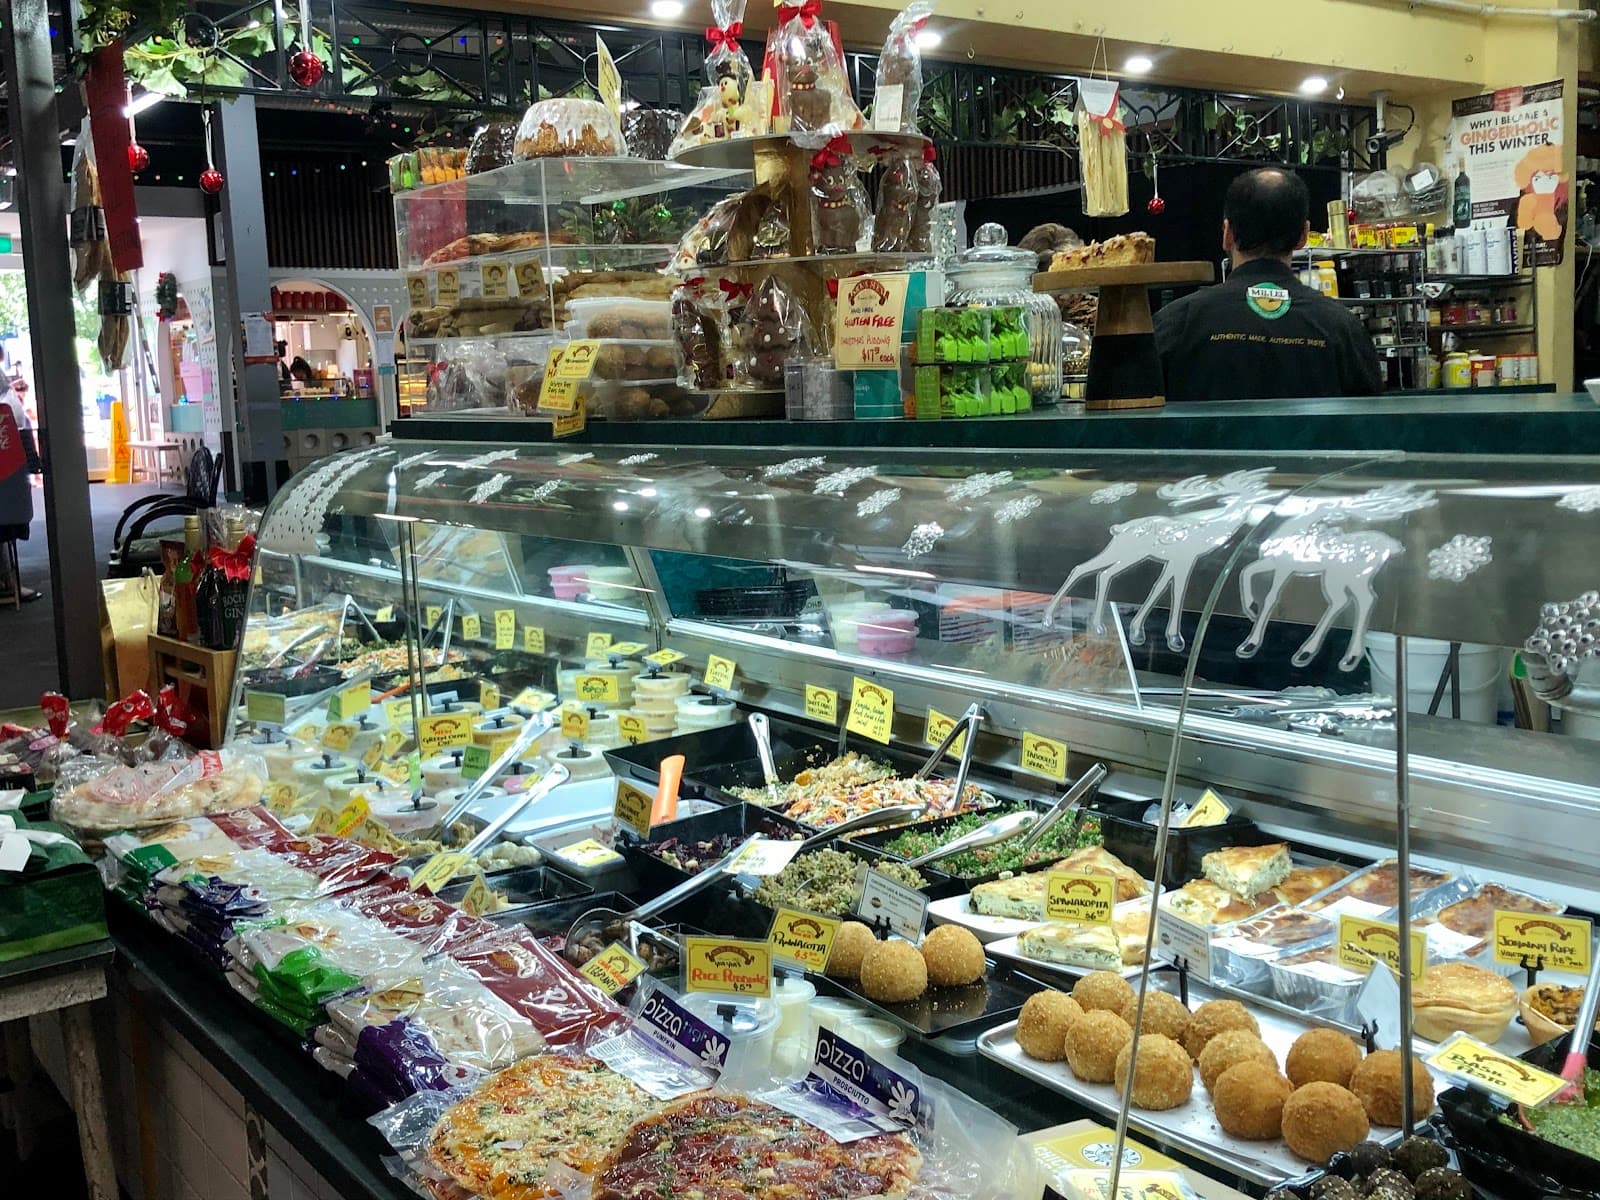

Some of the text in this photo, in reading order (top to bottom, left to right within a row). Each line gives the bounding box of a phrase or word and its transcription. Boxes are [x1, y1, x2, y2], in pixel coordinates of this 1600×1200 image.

[1460, 116, 1559, 145] GINGERHOLIC
[1470, 119, 1492, 130] WHY
[1469, 133, 1549, 156] THIS WINTER
[872, 315, 895, 328] FREE
[1049, 895, 1109, 910] SPANAKOPITA
[1498, 935, 1546, 952] JOHNNY
[692, 968, 721, 981] RICE
[640, 998, 682, 1037] pizza
[653, 1029, 677, 1050] PUMPKIN
[815, 1038, 865, 1082] pizza
[832, 1076, 870, 1105] PROSCIUTTO
